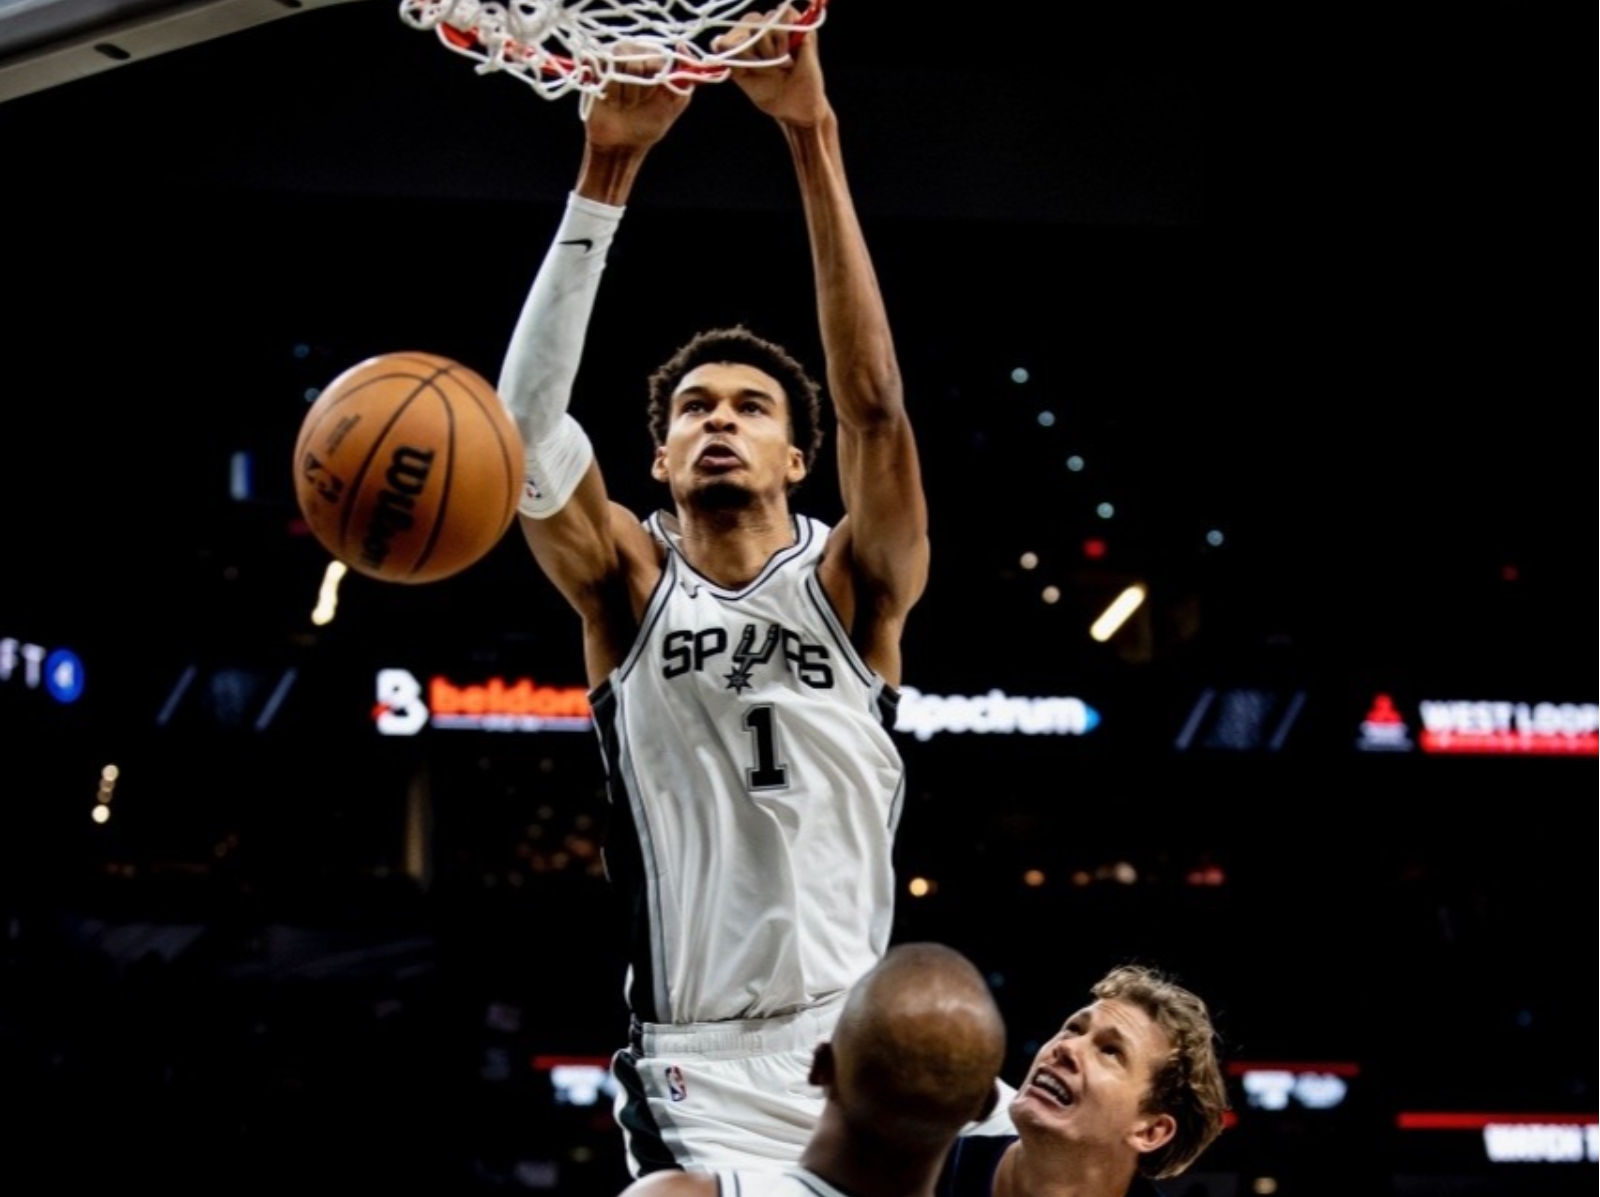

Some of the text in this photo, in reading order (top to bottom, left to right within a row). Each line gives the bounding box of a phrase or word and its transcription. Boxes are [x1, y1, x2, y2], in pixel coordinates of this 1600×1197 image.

[362, 446, 434, 569] Wilson
[662, 624, 834, 692] SPURS
[741, 702, 789, 792] 1
[893, 685, 1088, 741] Spectrum
